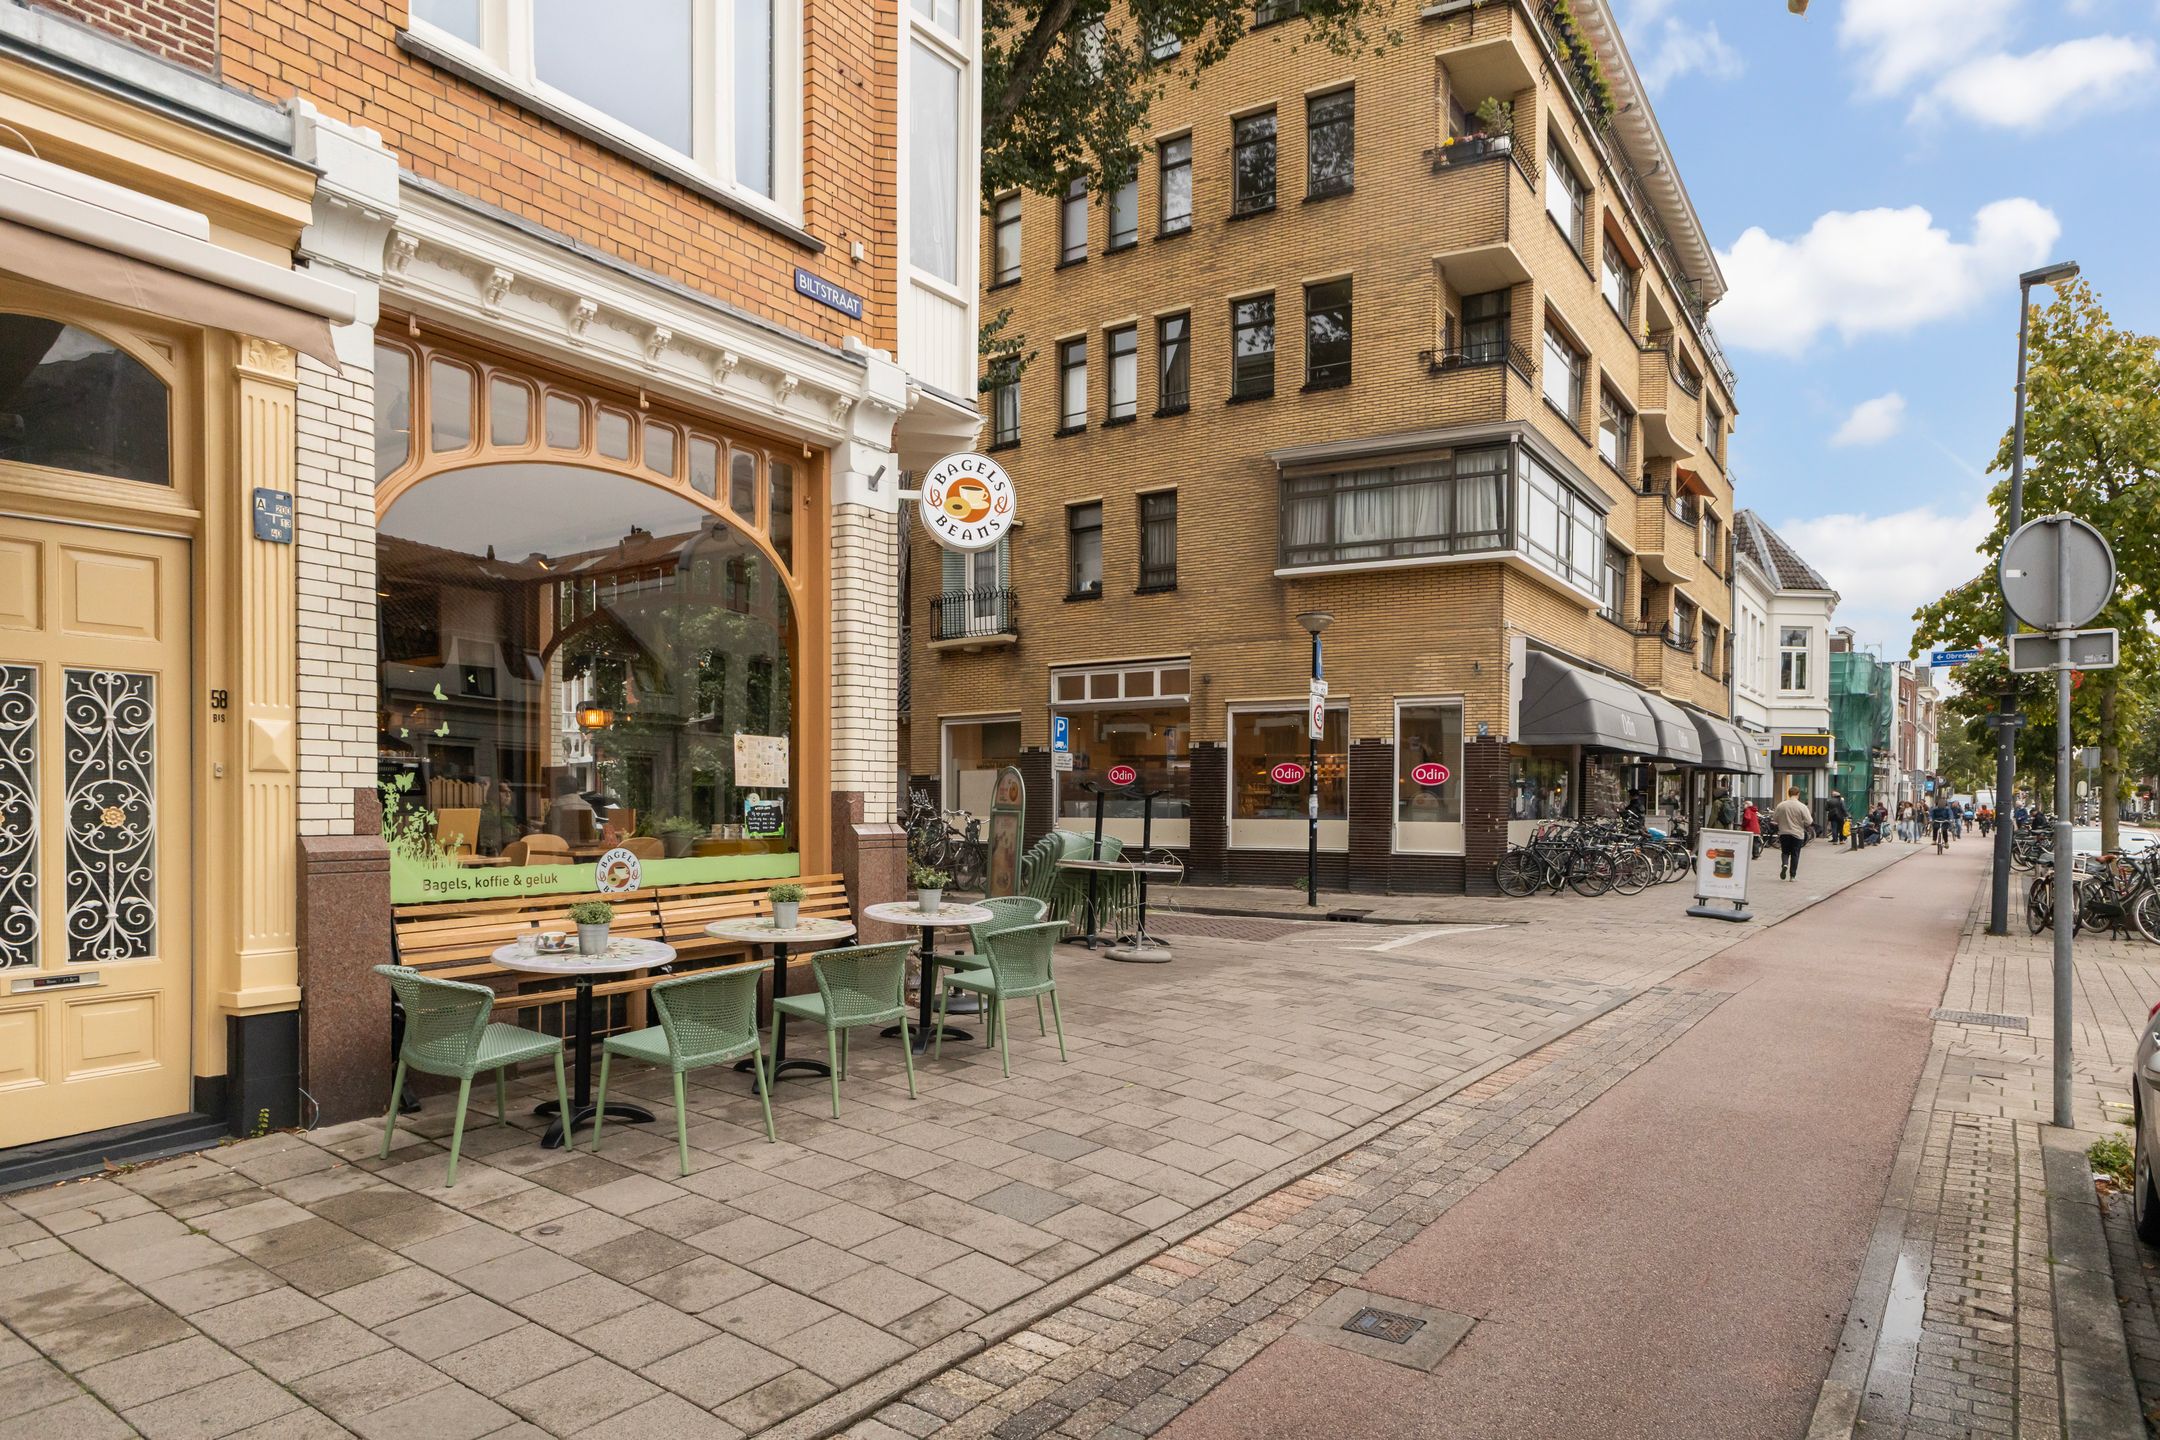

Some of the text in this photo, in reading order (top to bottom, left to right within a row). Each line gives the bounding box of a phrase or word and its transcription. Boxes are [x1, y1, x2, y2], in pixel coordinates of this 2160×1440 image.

[800, 274, 860, 313] BILTSTRAAT
[934, 459, 1006, 492] BAGELS
[256, 499, 266, 510] A
[936, 515, 1000, 541] BEANS
[211, 689, 228, 709] 58
[212, 713, 226, 723] BIS
[1057, 719, 1066, 737] P
[1781, 745, 1828, 756] JUMBO
[1111, 770, 1133, 780] Odin
[1275, 768, 1301, 779] Odin
[1415, 768, 1445, 780] Odin
[601, 851, 636, 868] BAGELS
[423, 873, 559, 894] Bagels, koffie & geluk
